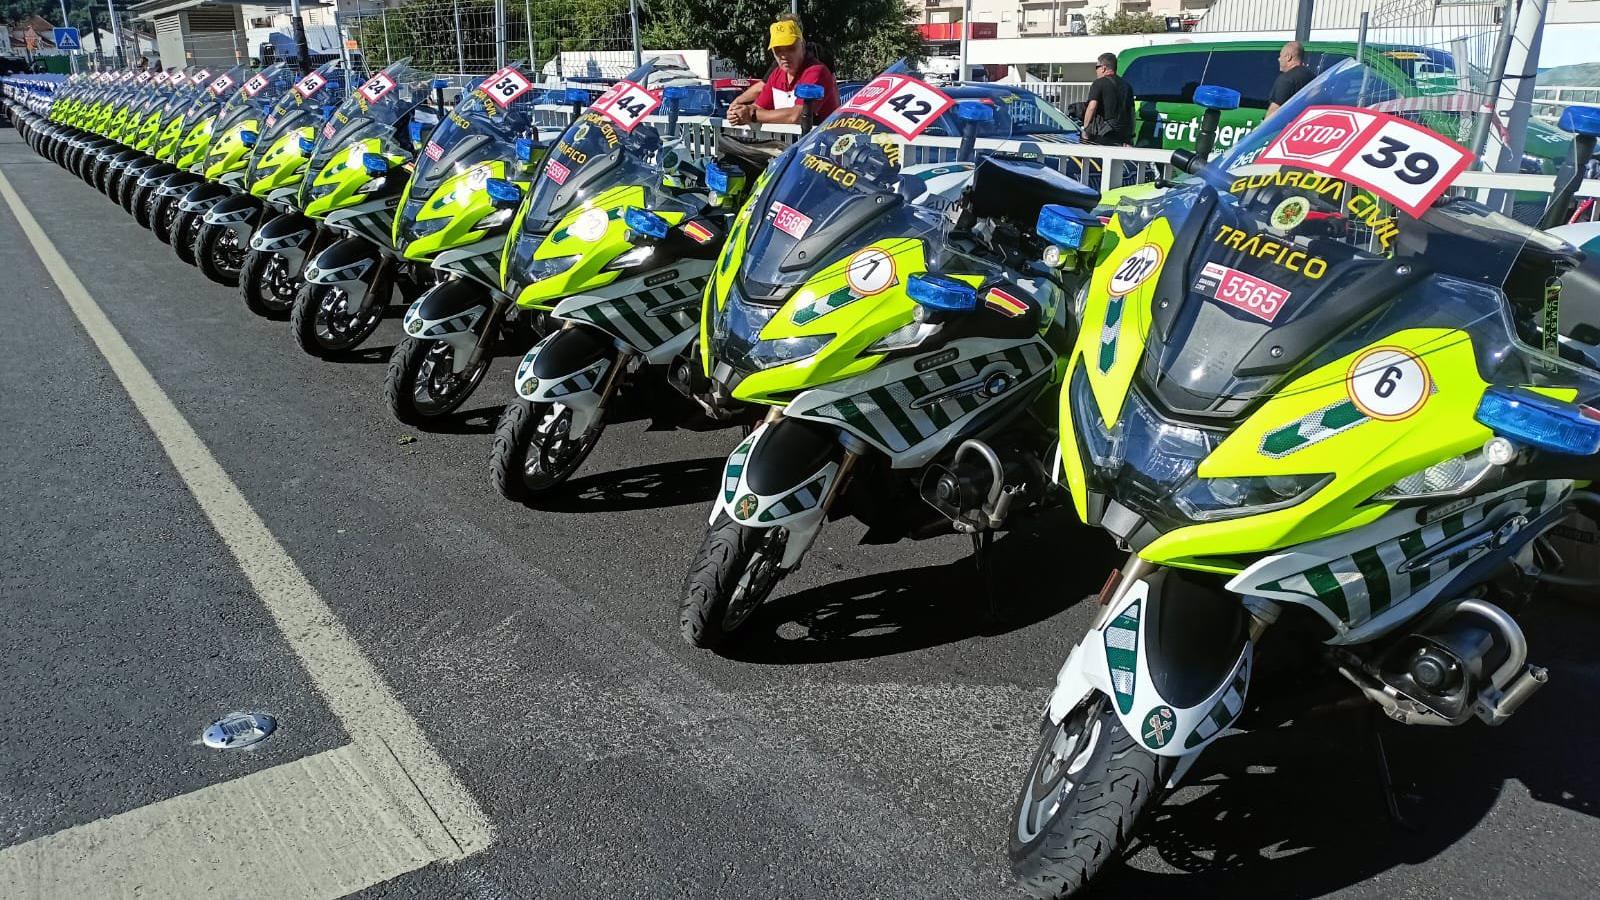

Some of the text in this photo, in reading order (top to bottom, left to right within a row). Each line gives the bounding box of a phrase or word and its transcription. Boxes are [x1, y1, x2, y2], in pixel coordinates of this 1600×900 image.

[216, 79, 227, 89] 21
[249, 79, 262, 90] 33
[304, 78, 318, 91] 46
[367, 80, 386, 95] 24
[495, 77, 519, 97] 36
[617, 96, 646, 119] 44
[859, 86, 932, 124] STOP 42
[1292, 124, 1440, 185] STOP 39
[1230, 171, 1400, 248] GUARDIA CIVIL
[1213, 224, 1328, 280] TRÁFICO
[1222, 276, 1283, 314] 5565
[1374, 366, 1403, 398] 6
